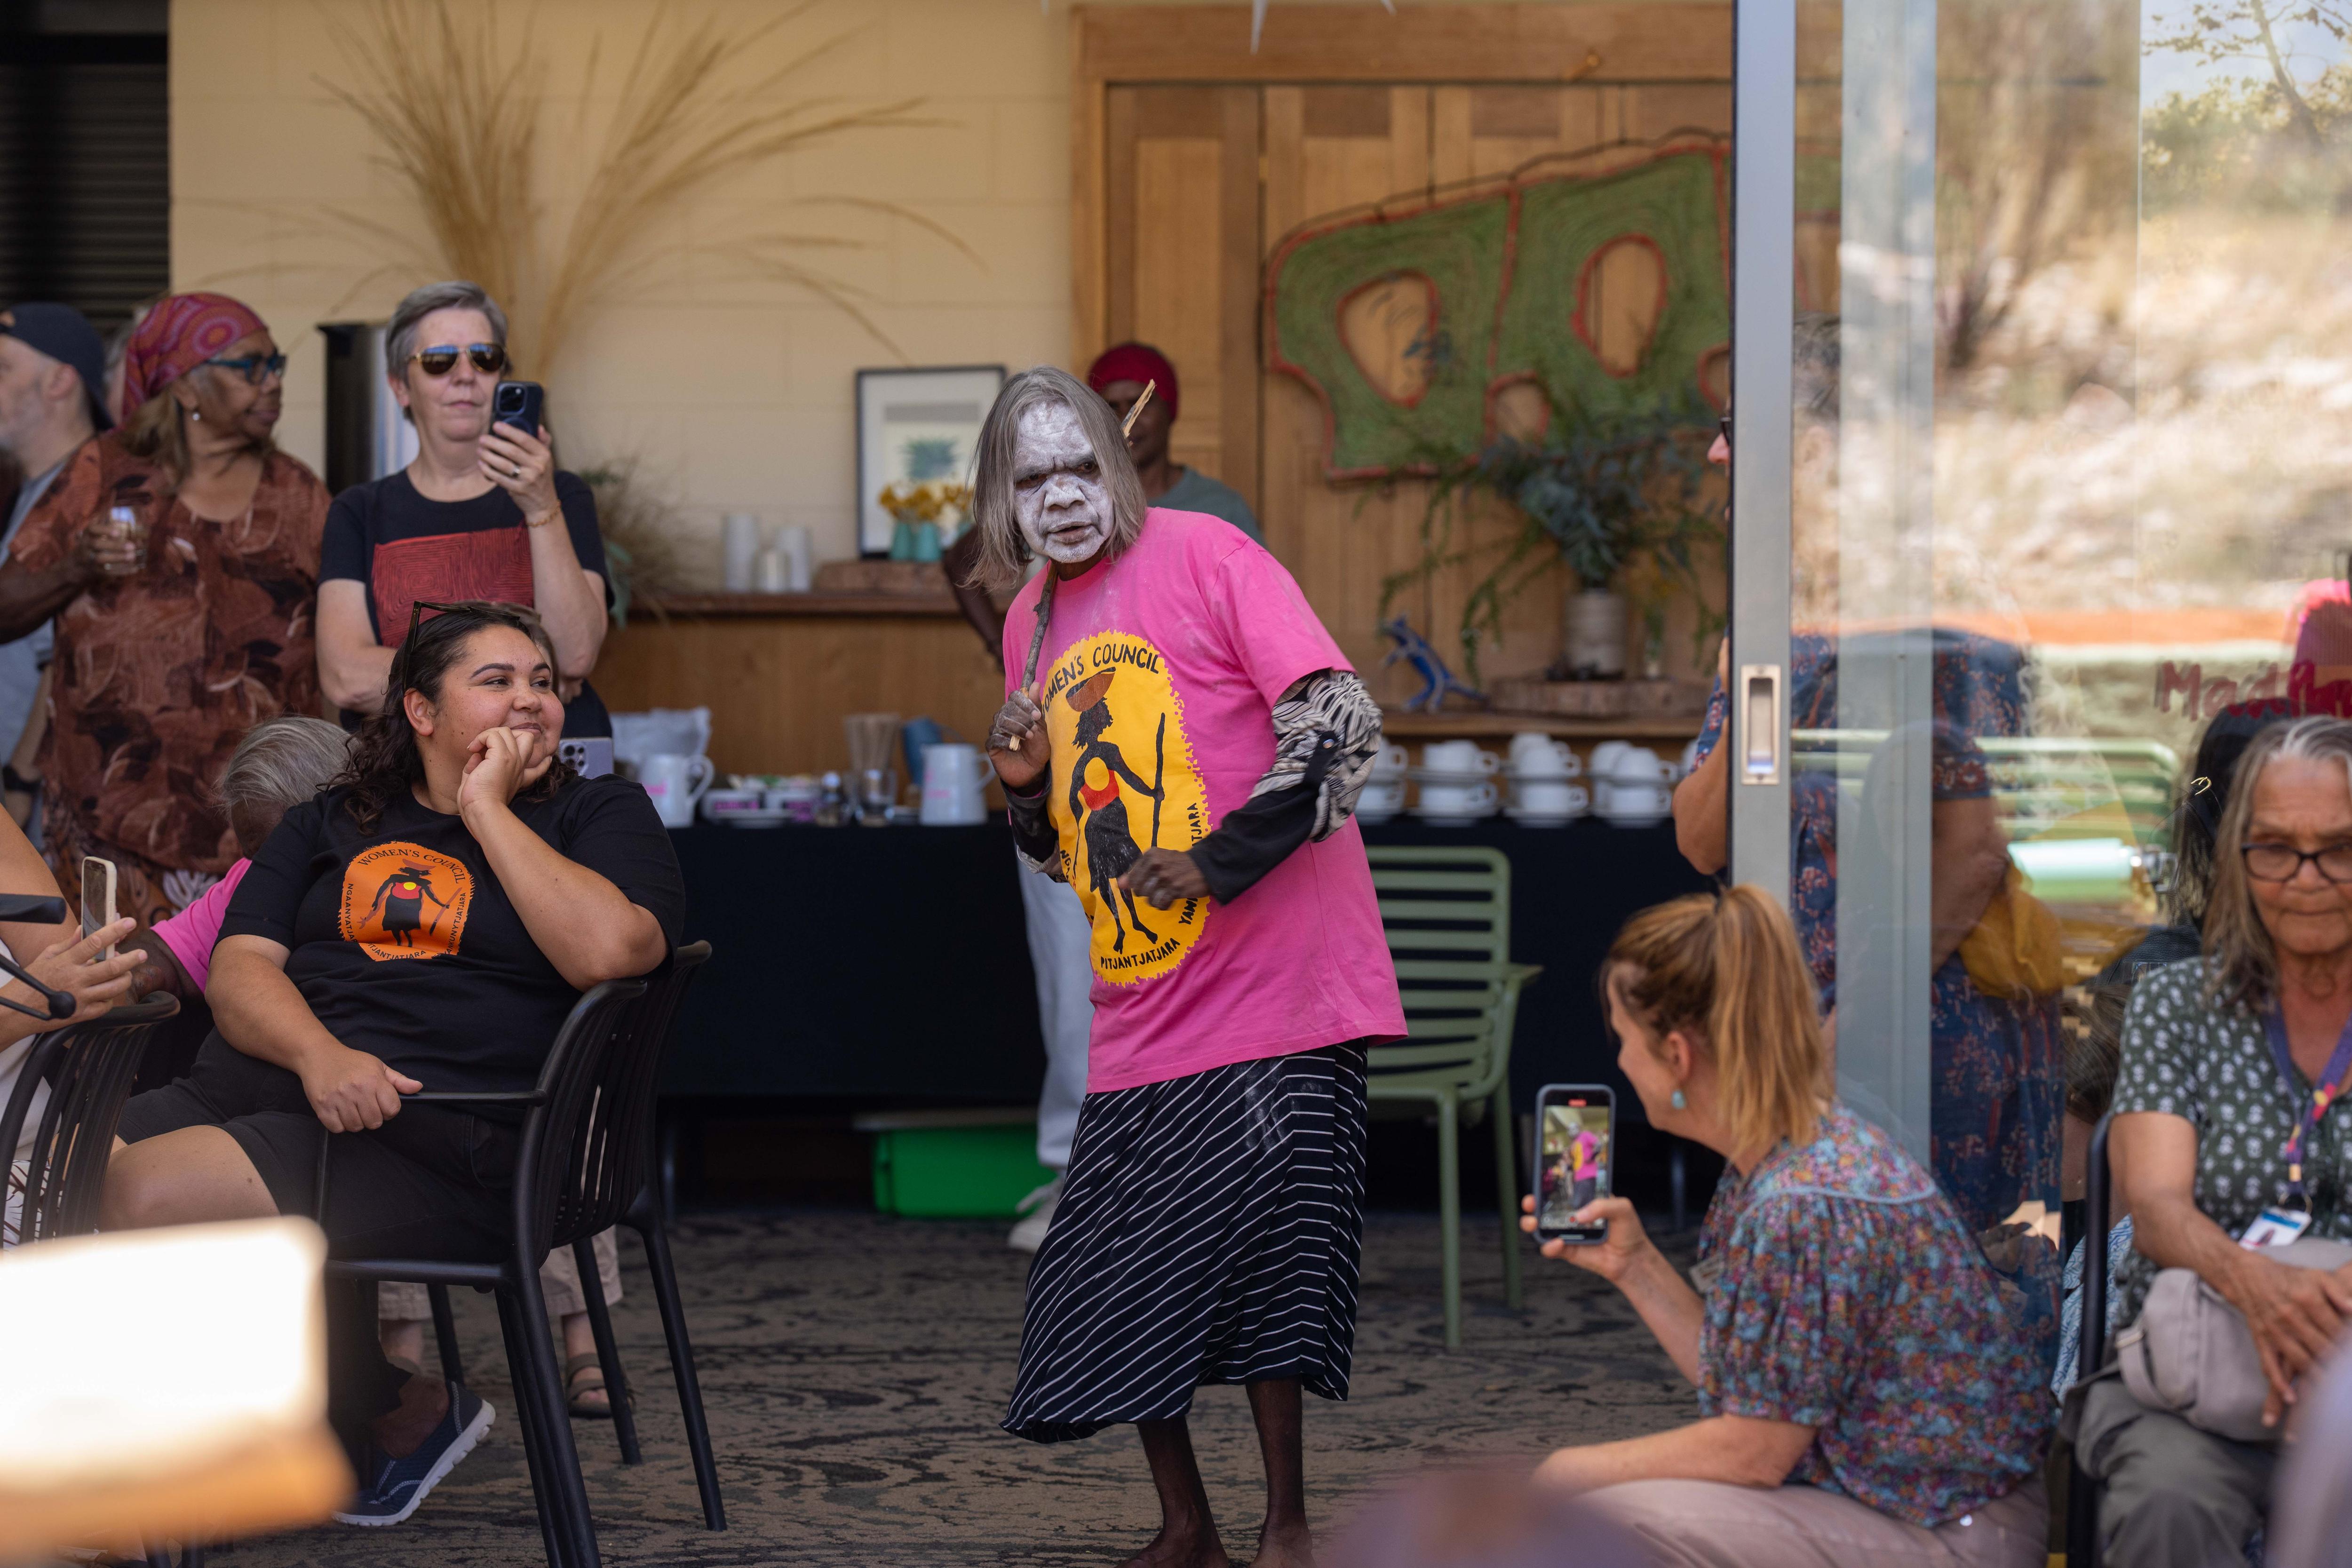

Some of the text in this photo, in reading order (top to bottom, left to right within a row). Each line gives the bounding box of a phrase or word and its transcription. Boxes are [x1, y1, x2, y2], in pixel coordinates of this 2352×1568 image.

[1093, 643, 1159, 674] COUNCIL
[358, 849, 466, 883] WOMEN'S COUNCIL
[368, 943, 426, 959] ITJANTJATJARA
[1101, 938, 1181, 970] PITJANTJATJARA
